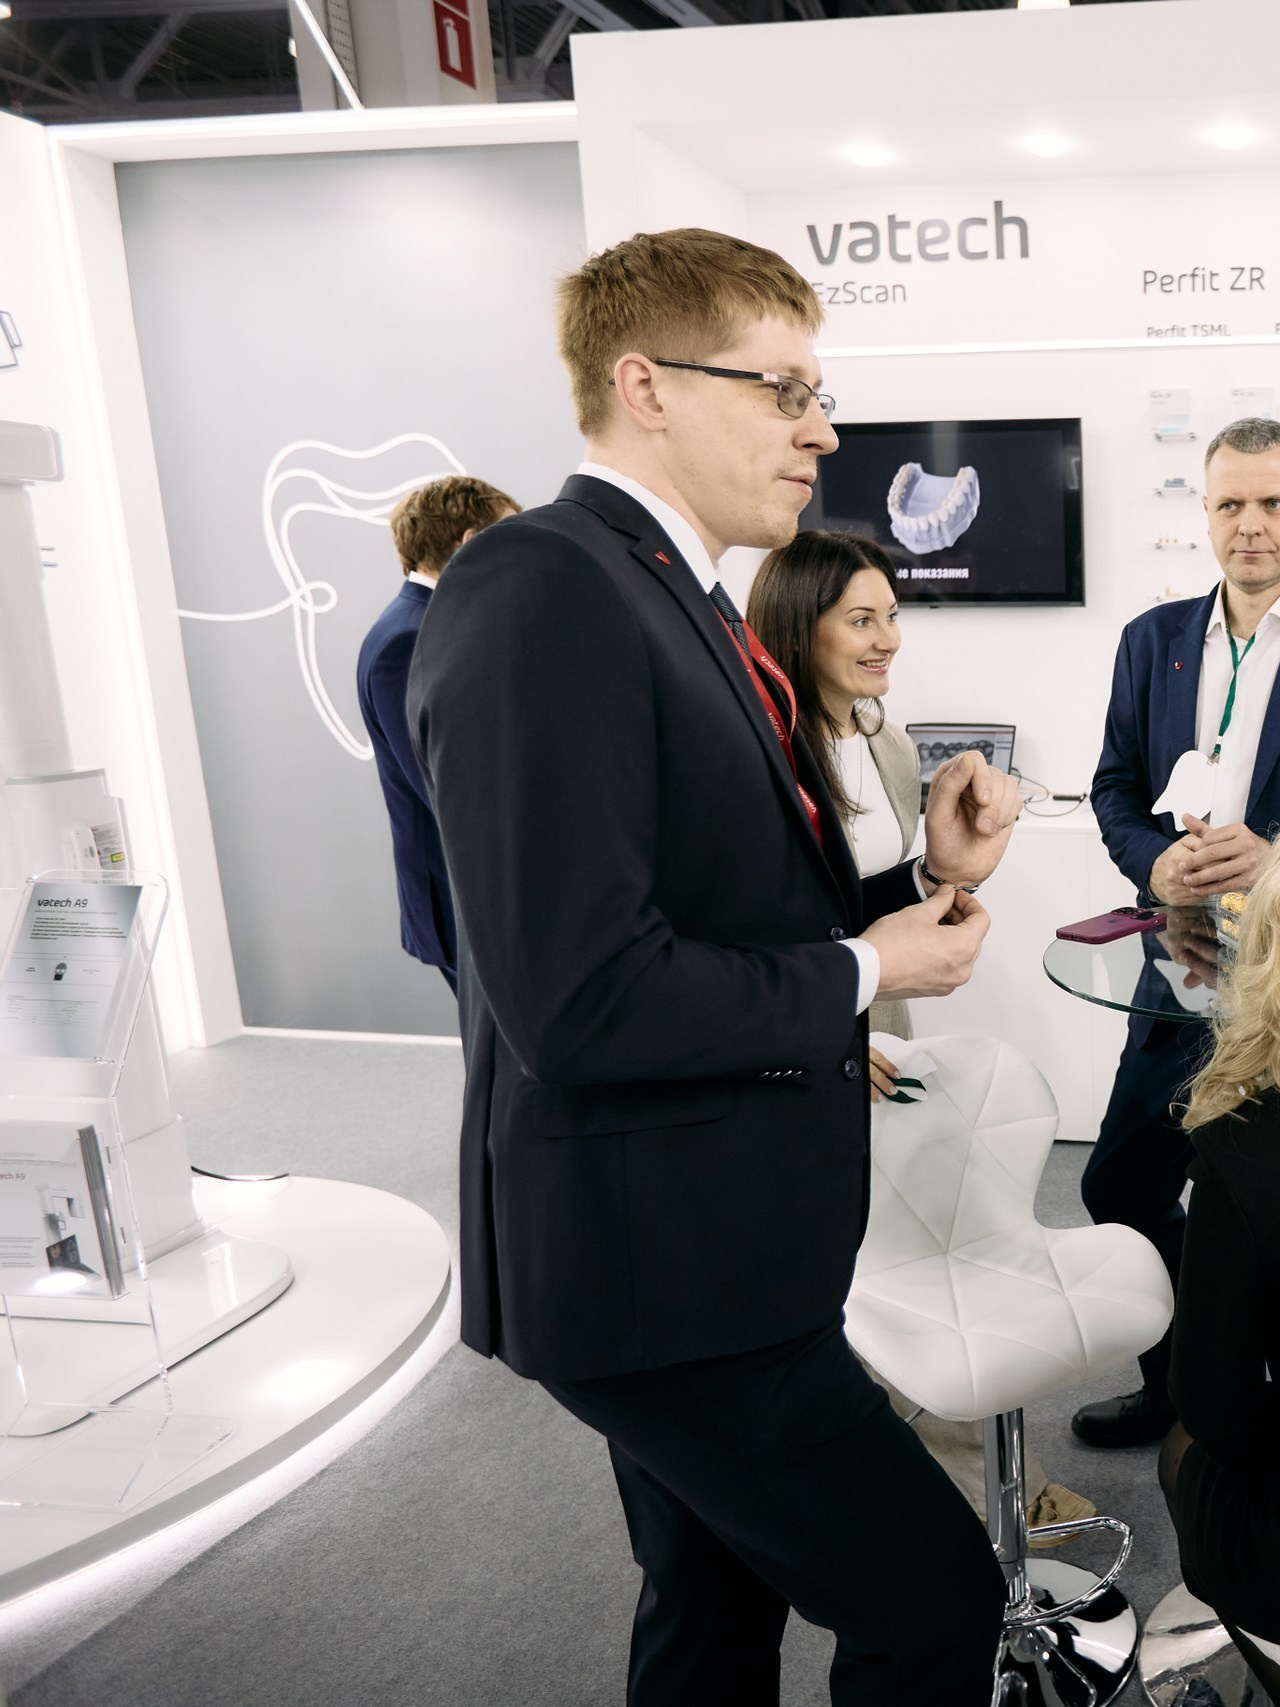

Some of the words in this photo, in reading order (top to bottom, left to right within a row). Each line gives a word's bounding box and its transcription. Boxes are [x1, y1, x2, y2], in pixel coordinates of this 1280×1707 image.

[806, 200, 1030, 267] vatech
[1142, 266, 1221, 294] Perfit
[1229, 266, 1266, 291] ZR
[1146, 325, 1187, 338] Perfit
[1191, 324, 1231, 337] TSML
[911, 568, 969, 579] показания
[760, 655, 785, 680] vatech
[37, 898, 72, 908] vatech
[73, 898, 89, 908] A9
